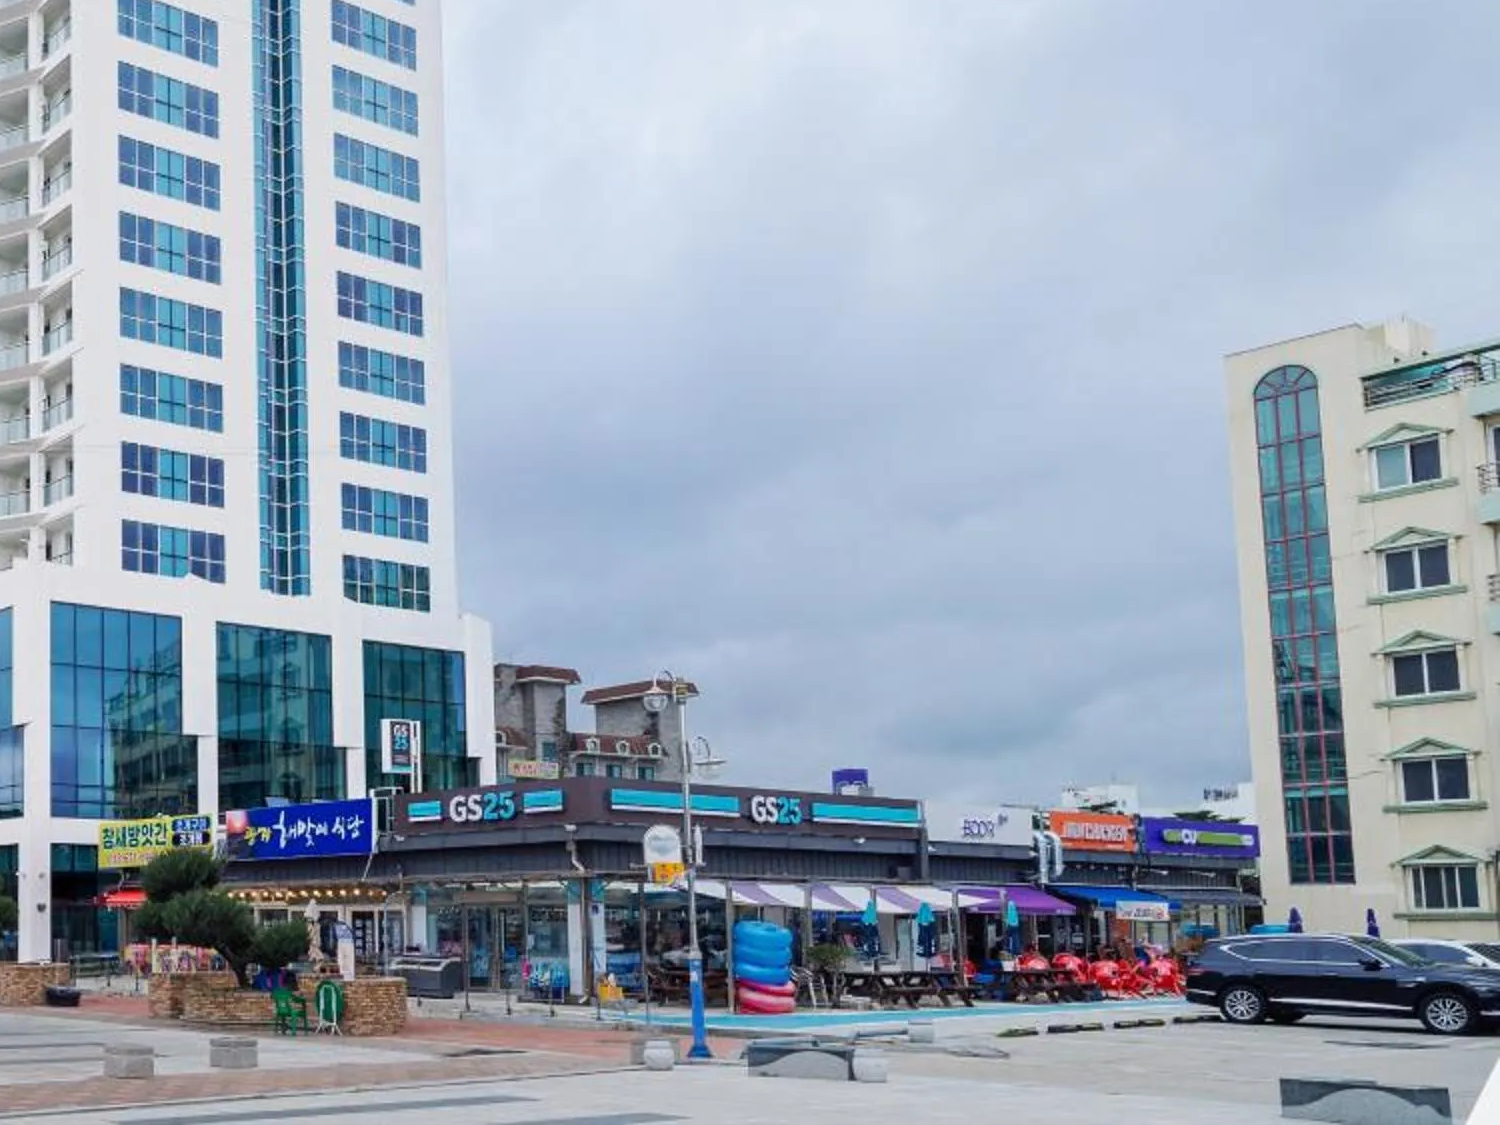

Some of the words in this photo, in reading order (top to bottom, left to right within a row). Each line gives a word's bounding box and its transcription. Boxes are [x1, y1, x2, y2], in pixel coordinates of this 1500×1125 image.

[449, 790, 516, 823] GS25
[751, 794, 802, 824] GS25
[102, 821, 167, 850] 참새방앗간
[331, 814, 365, 840] 식당
